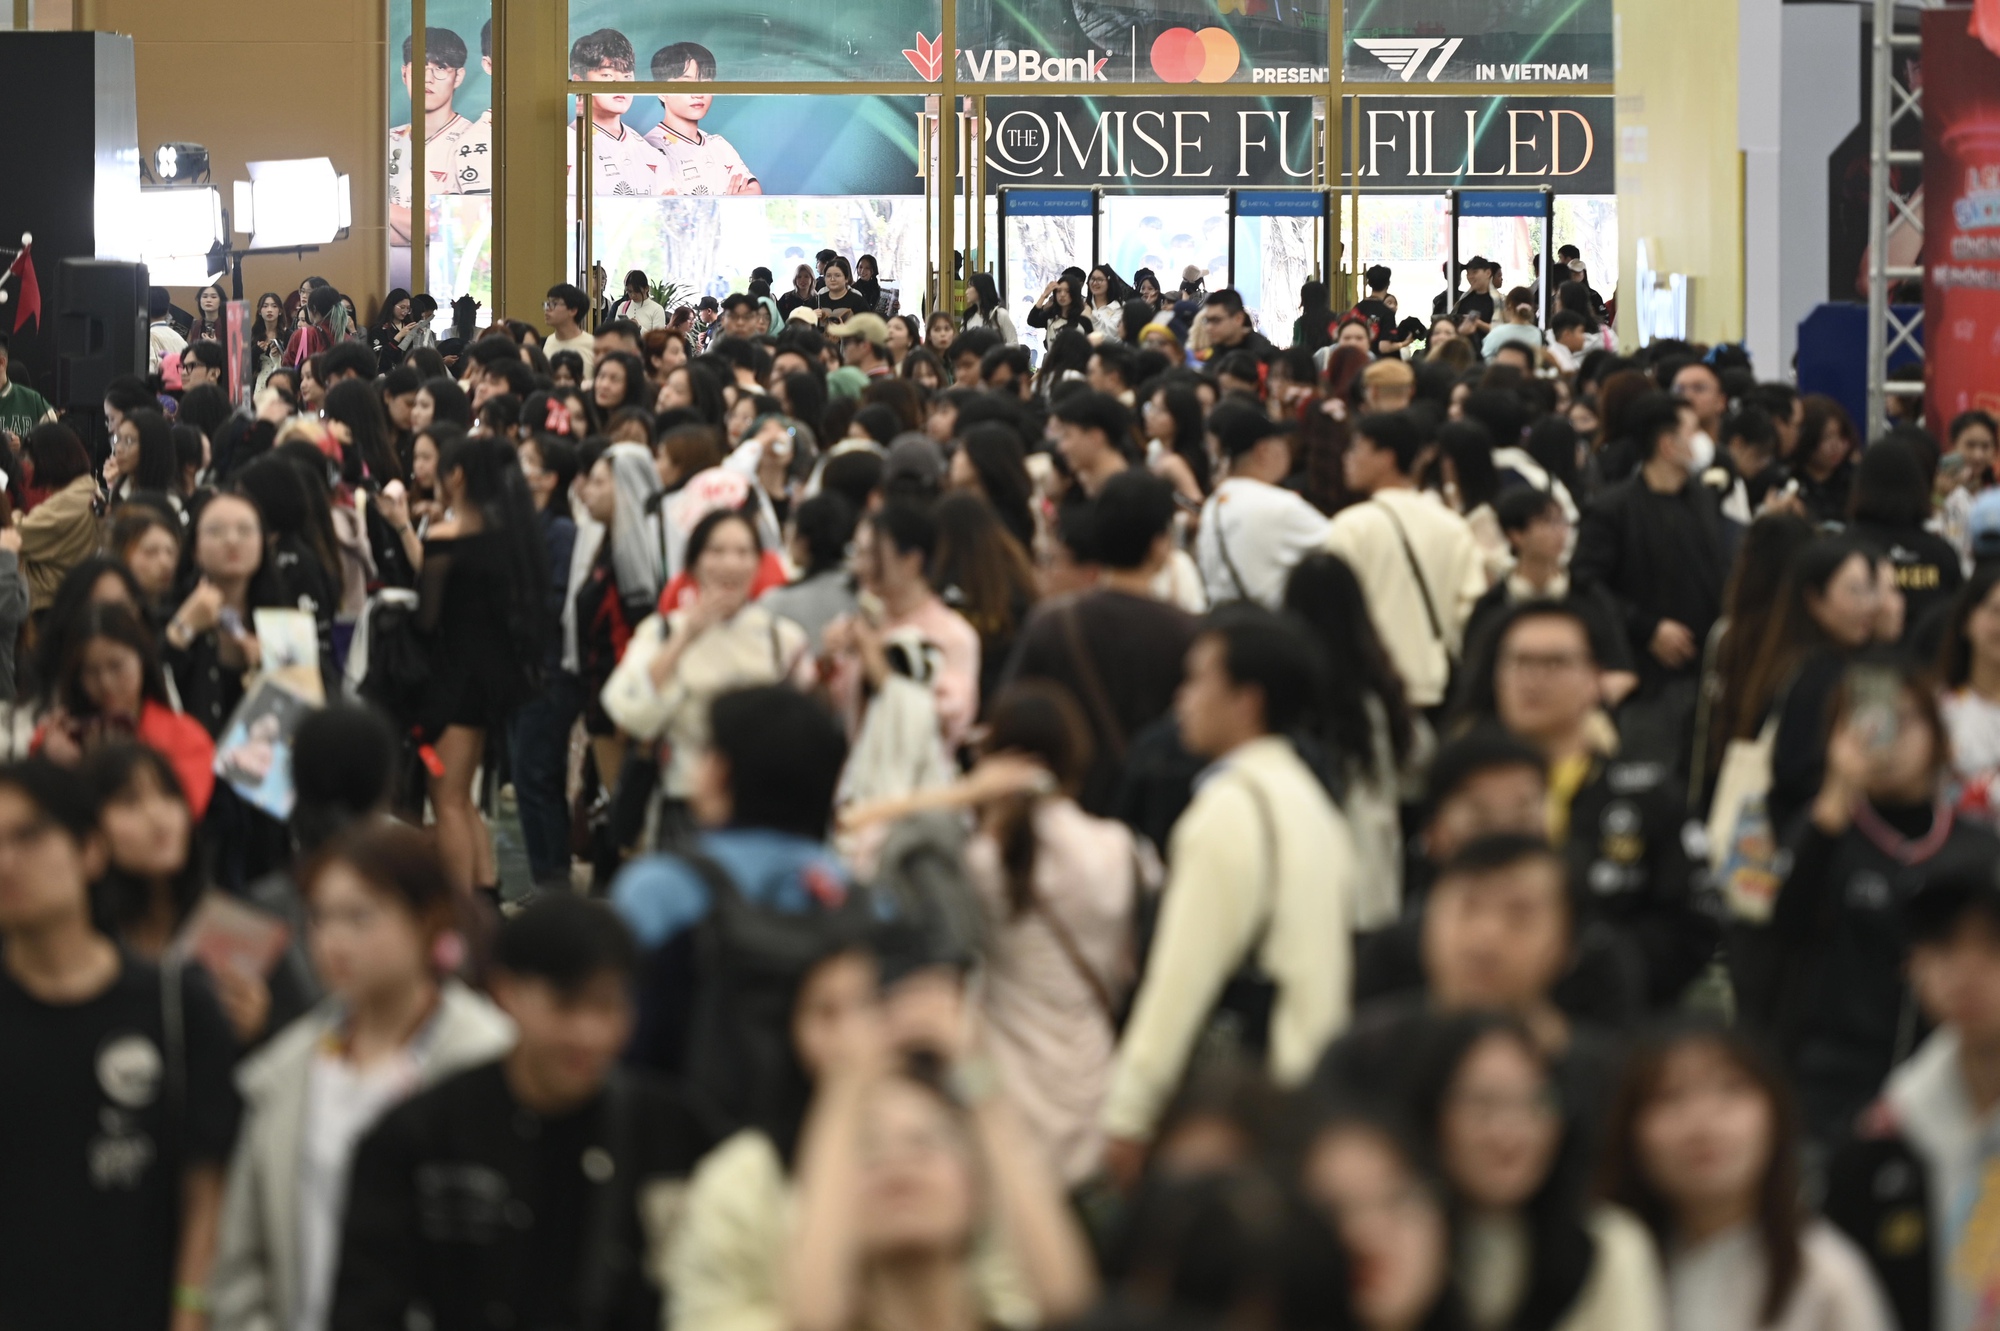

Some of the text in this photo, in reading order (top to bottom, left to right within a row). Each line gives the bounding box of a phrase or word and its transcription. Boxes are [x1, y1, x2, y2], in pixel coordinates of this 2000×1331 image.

[964, 38, 1588, 84] VPBank PRESENT T1 IN VIETNAM
[1007, 129, 1039, 147] THE
[1236, 109, 1594, 178] FUFILLED
